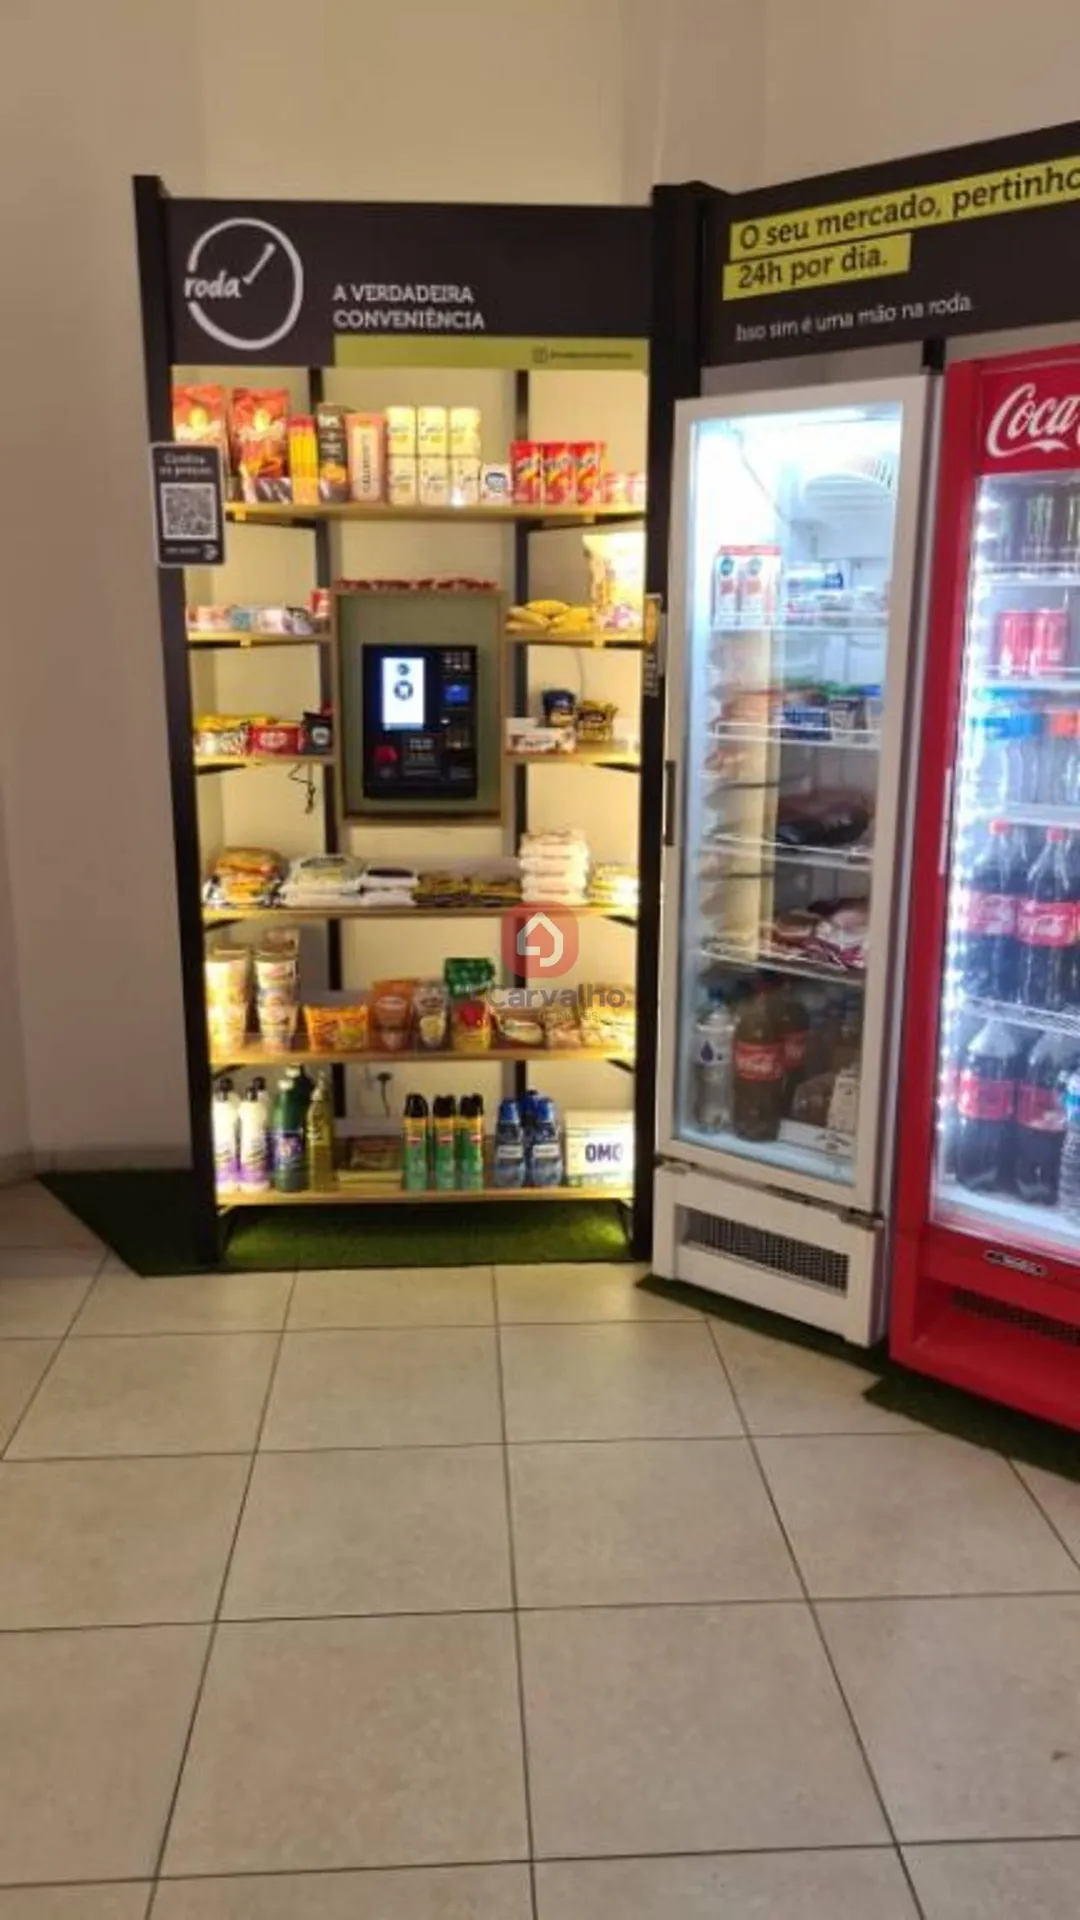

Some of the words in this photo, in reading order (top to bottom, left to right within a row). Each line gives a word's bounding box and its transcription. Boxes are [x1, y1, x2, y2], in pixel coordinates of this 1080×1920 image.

[739, 224, 760, 250] O
[766, 220, 810, 246] seu
[816, 193, 941, 235] mercado,
[952, 167, 1080, 218] pertinho
[184, 269, 242, 299] roda
[738, 260, 783, 288] 24h
[791, 255, 833, 286] por
[841, 245, 888, 272] dia.
[333, 284, 348, 302] A
[350, 284, 475, 304] VERDADEIRA
[332, 306, 485, 330] CONVENIÊNCIA
[735, 322, 766, 342] Isso
[769, 319, 799, 340] sim
[801, 316, 813, 334] é
[815, 313, 854, 333] uma
[858, 304, 897, 326] mão
[902, 302, 924, 321] na
